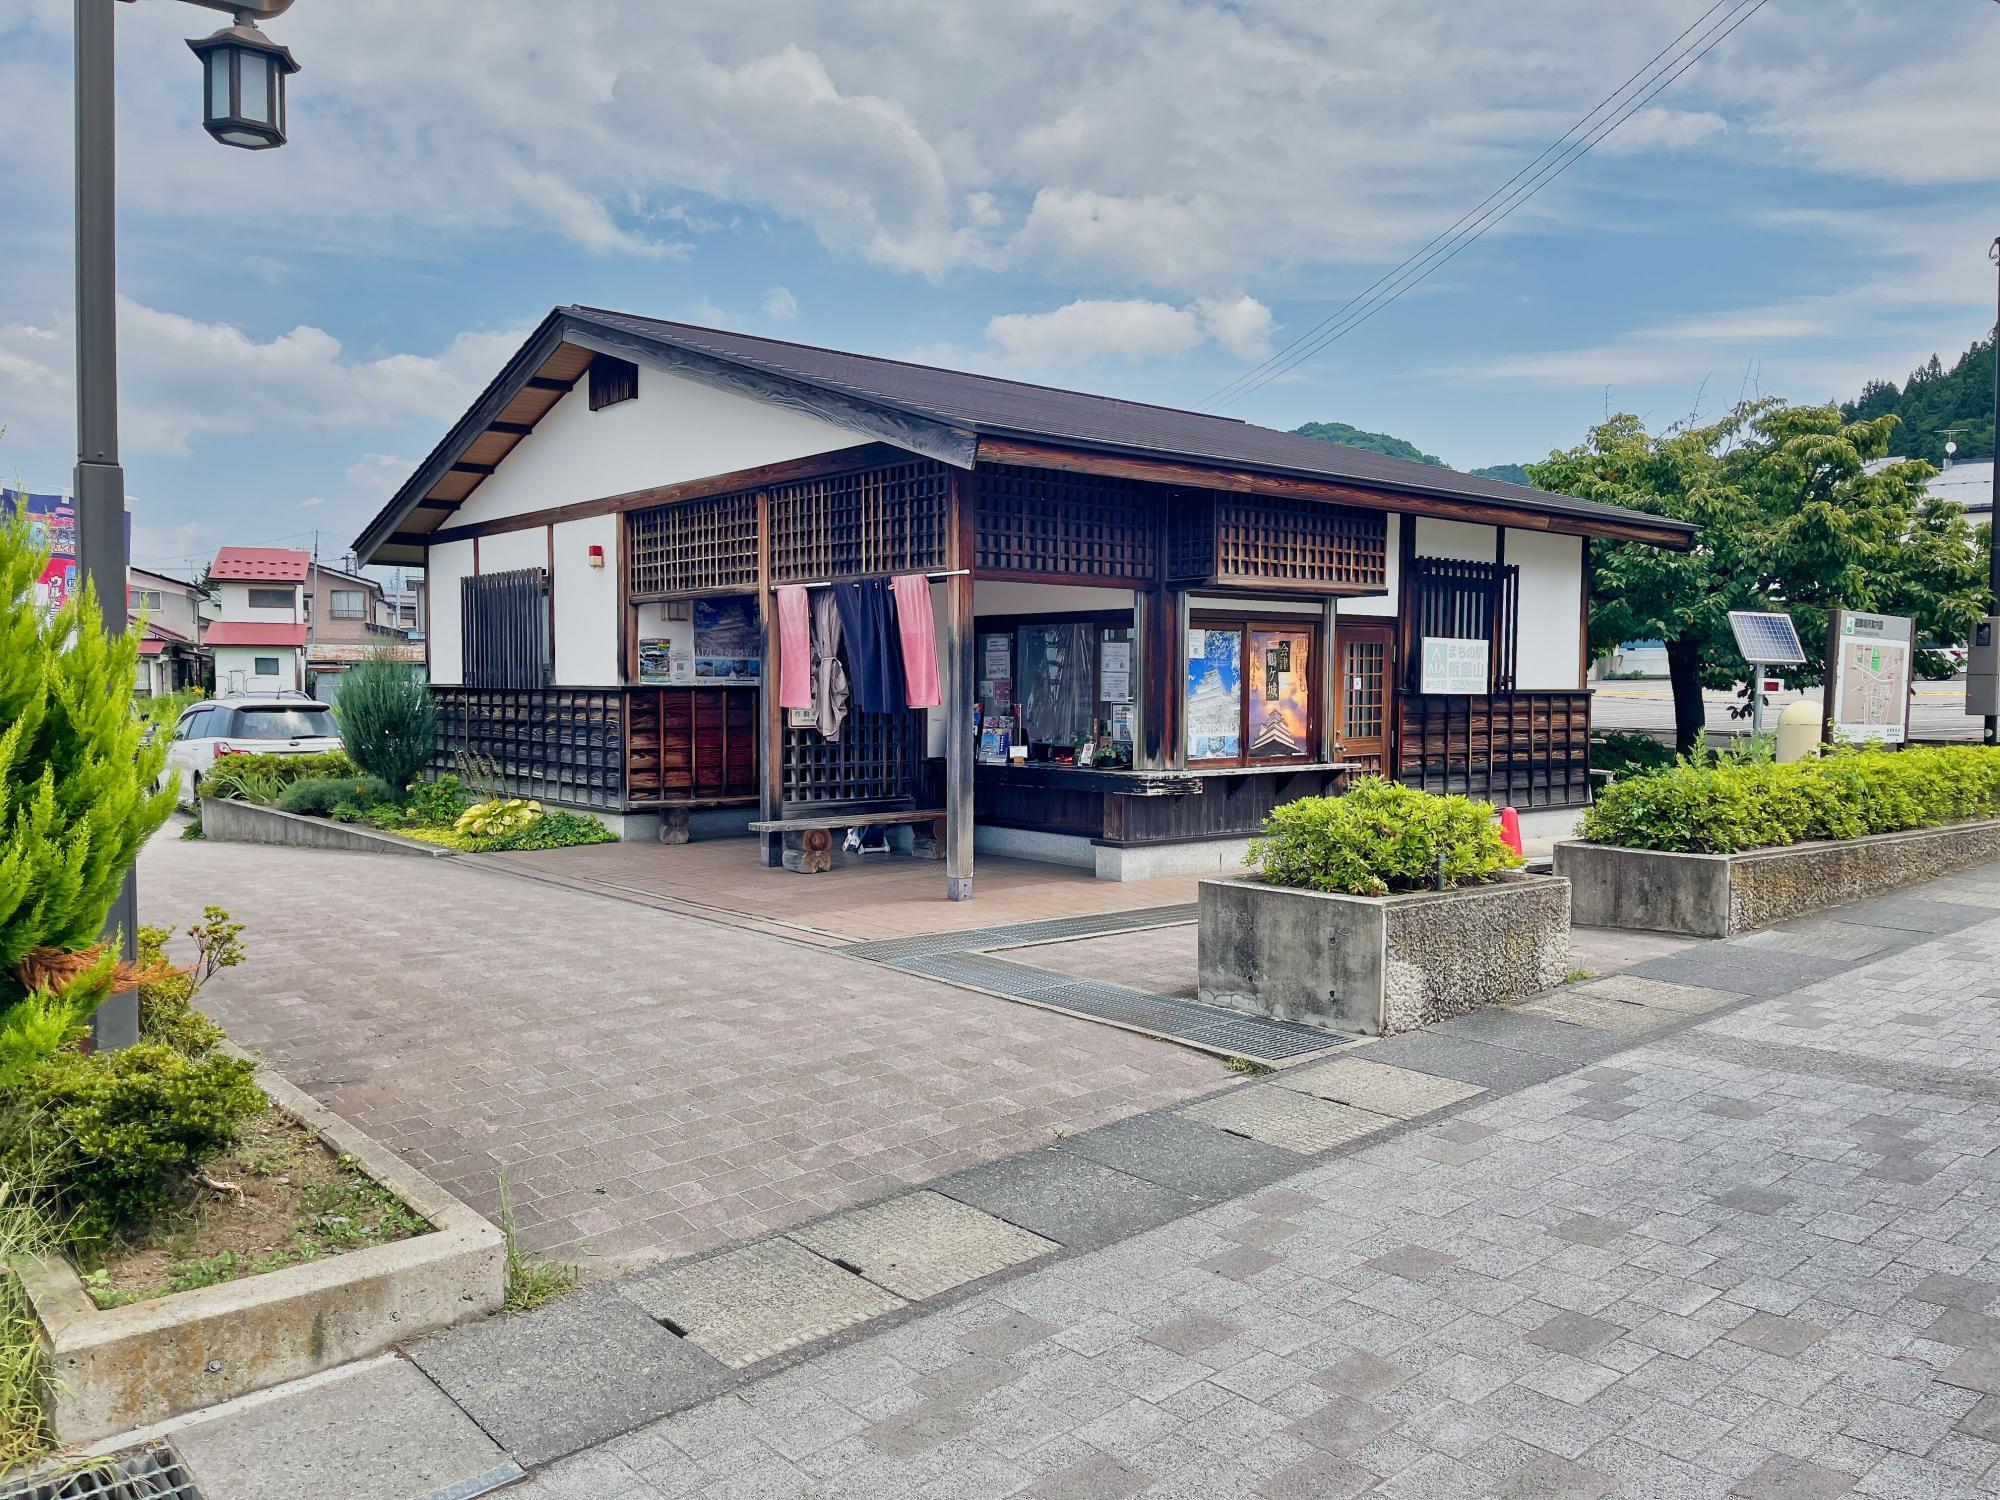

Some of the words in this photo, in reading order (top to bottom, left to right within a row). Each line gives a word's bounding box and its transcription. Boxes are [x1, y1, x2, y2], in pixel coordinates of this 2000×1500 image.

[1279, 643, 1289, 670] 会津
[1448, 644, 1484, 660] まちの駅
